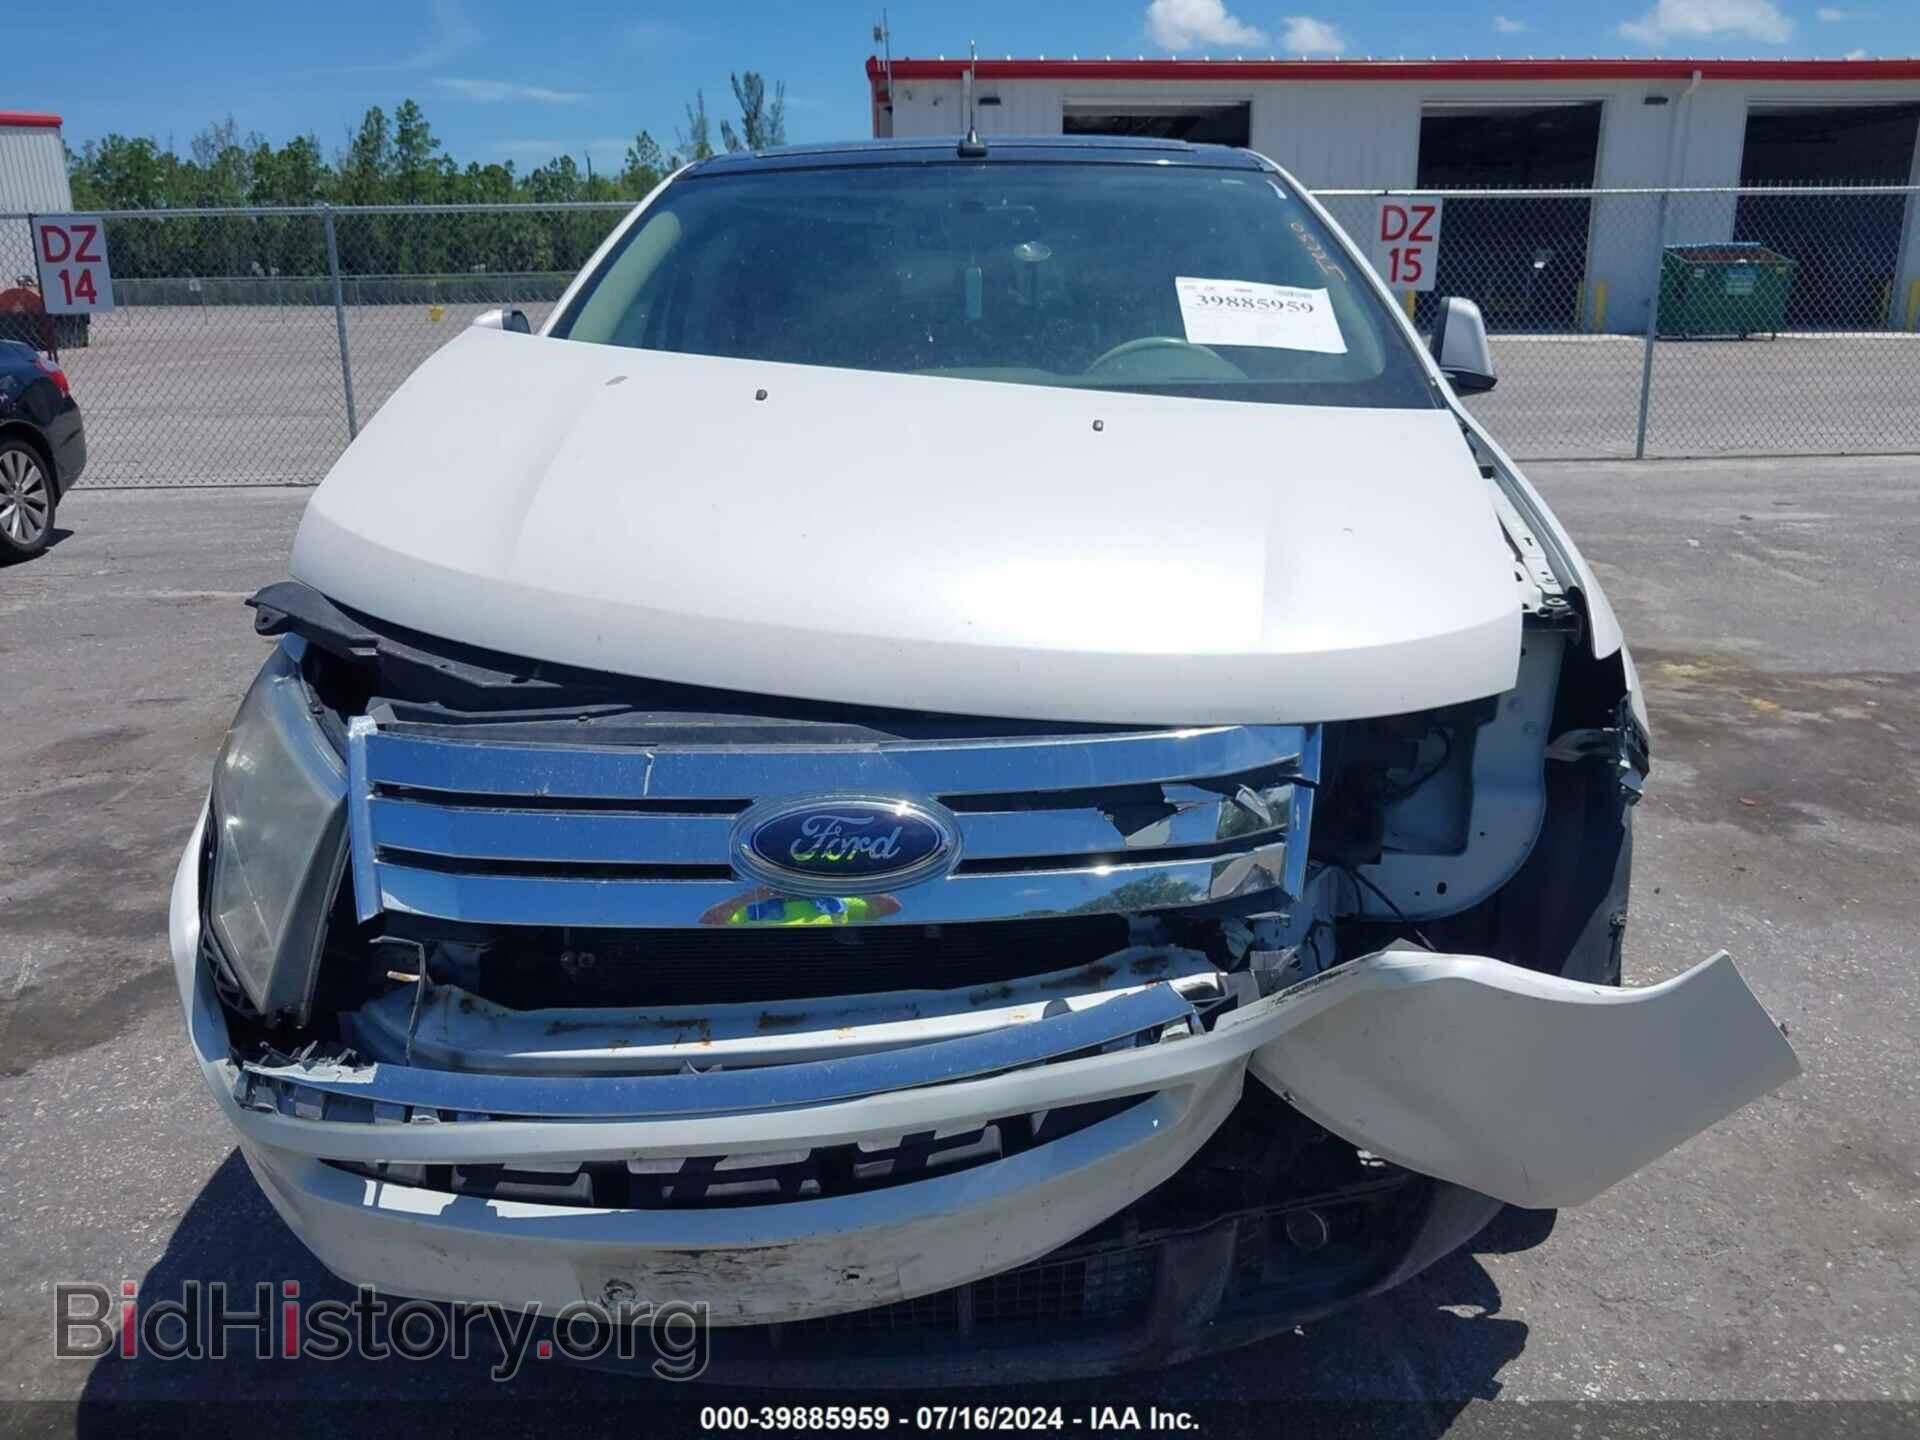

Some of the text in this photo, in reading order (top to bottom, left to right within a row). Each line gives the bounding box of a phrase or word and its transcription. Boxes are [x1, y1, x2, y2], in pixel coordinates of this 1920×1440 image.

[1381, 204, 1435, 242] DZ
[40, 224, 101, 263] DZ
[1389, 247, 1422, 283] 15
[58, 268, 97, 305] 14
[1196, 294, 1315, 314] 39885959
[789, 814, 903, 862] Ford
